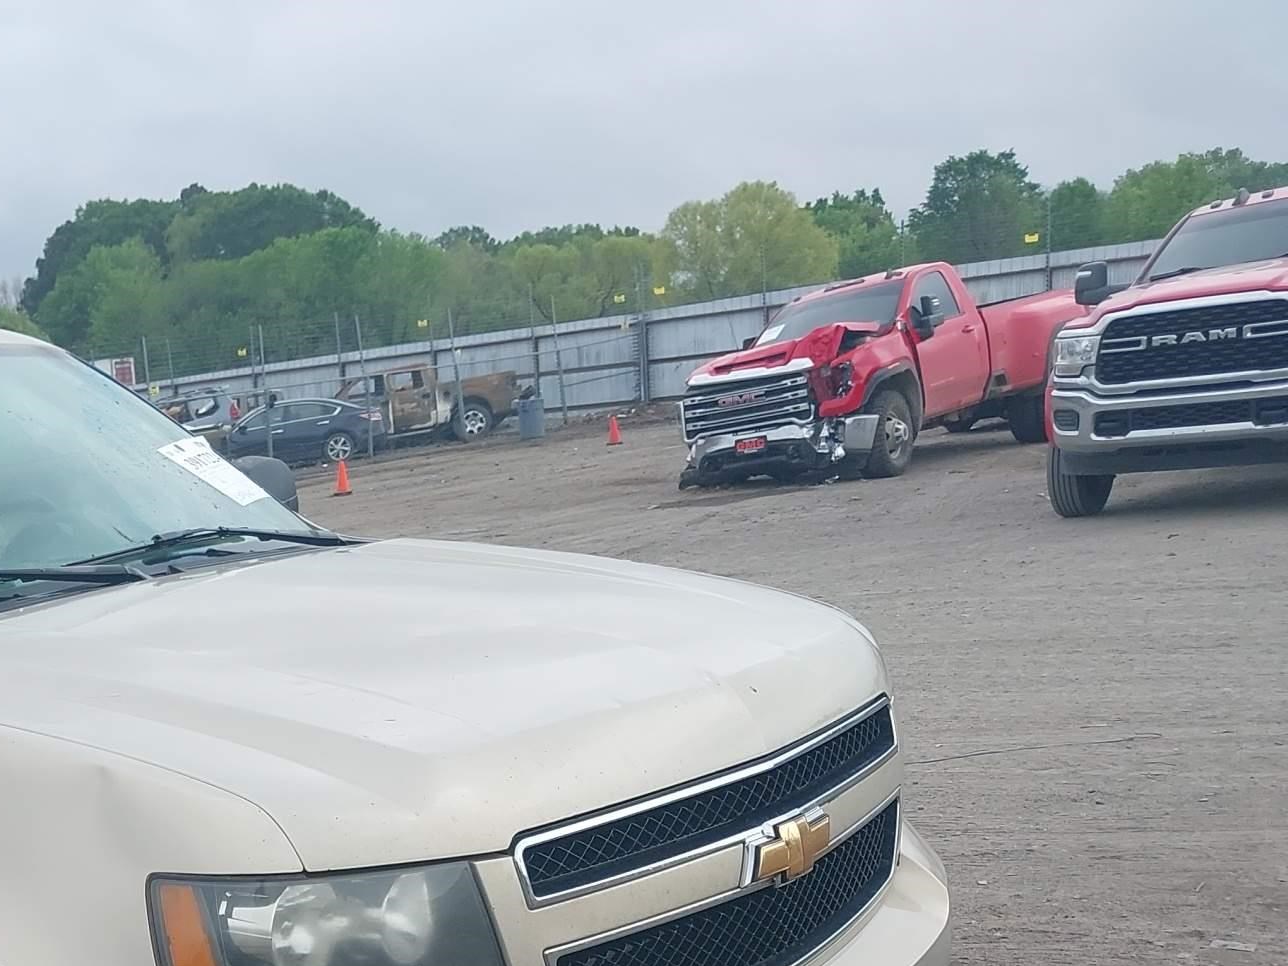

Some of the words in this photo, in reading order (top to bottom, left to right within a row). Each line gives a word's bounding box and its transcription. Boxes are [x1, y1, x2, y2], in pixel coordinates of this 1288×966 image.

[1151, 327, 1238, 346] RAM
[718, 390, 766, 407] GMC
[736, 437, 765, 451] GMC
